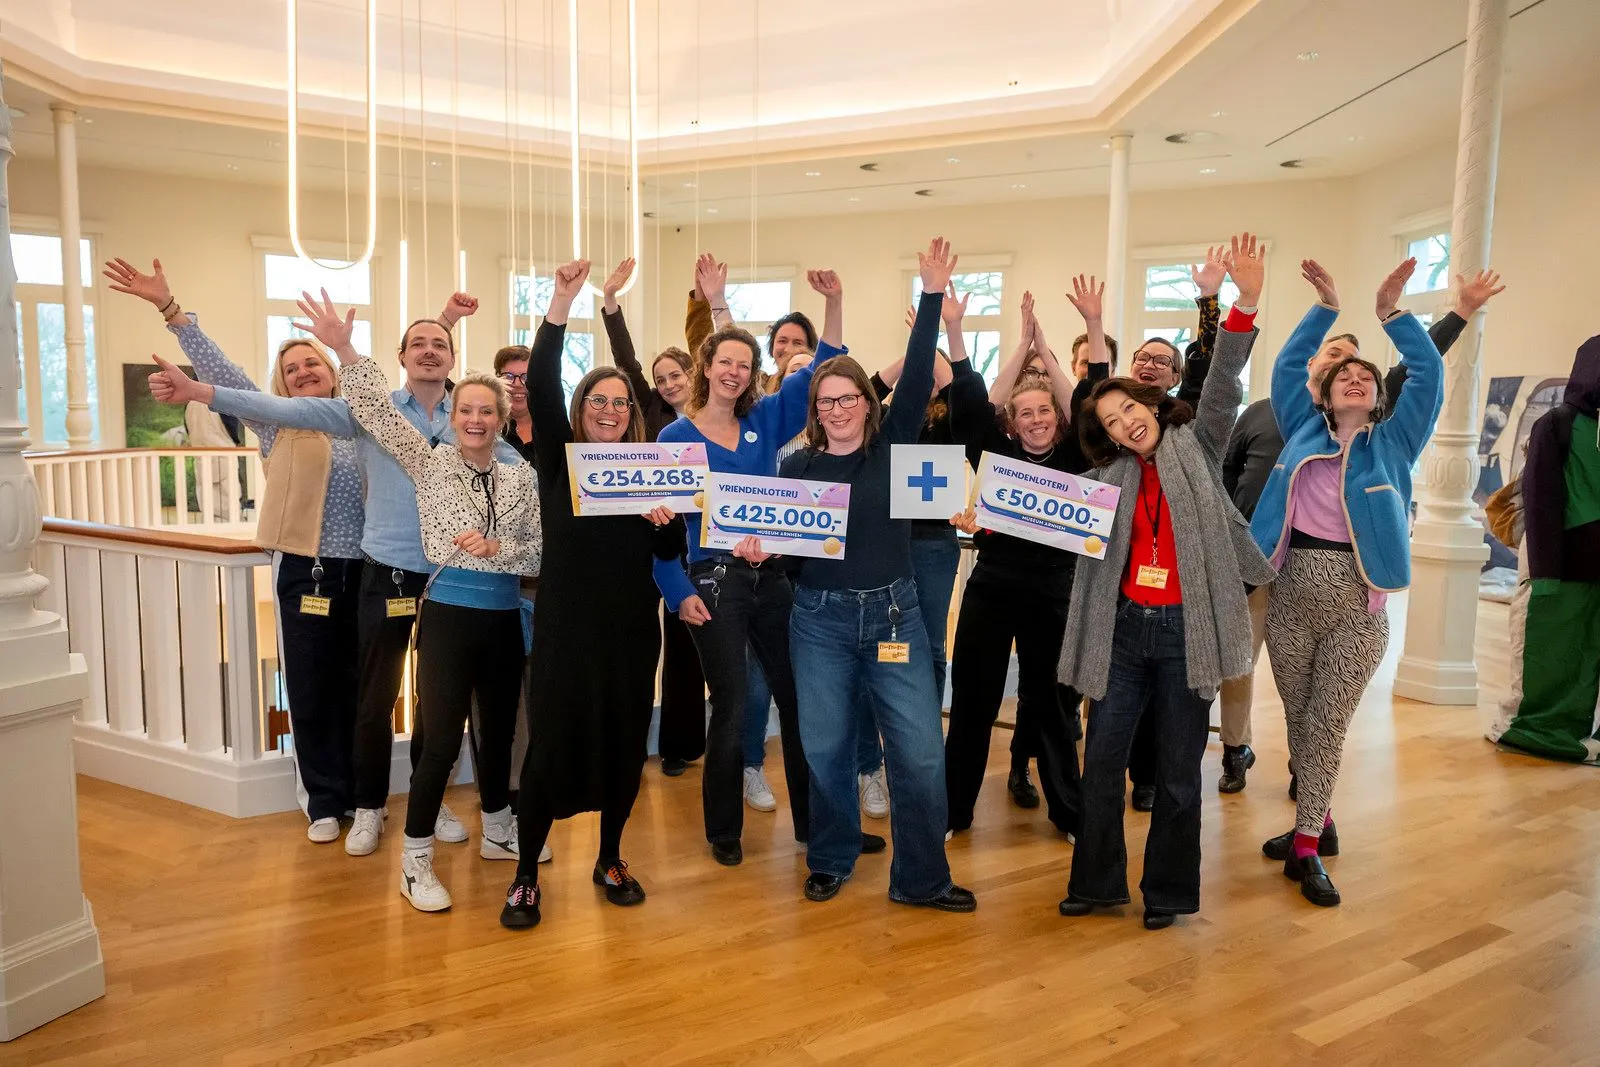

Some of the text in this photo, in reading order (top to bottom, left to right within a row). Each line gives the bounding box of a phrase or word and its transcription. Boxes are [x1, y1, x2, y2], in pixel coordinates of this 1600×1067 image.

[580, 453, 659, 461] VRIENDENLOTERIJ
[993, 465, 1069, 492] VRIENDENLOTERIJ
[718, 484, 798, 499] VRIENDENLOTERIJ
[1021, 515, 1066, 531] MUSEUM ARNHEM
